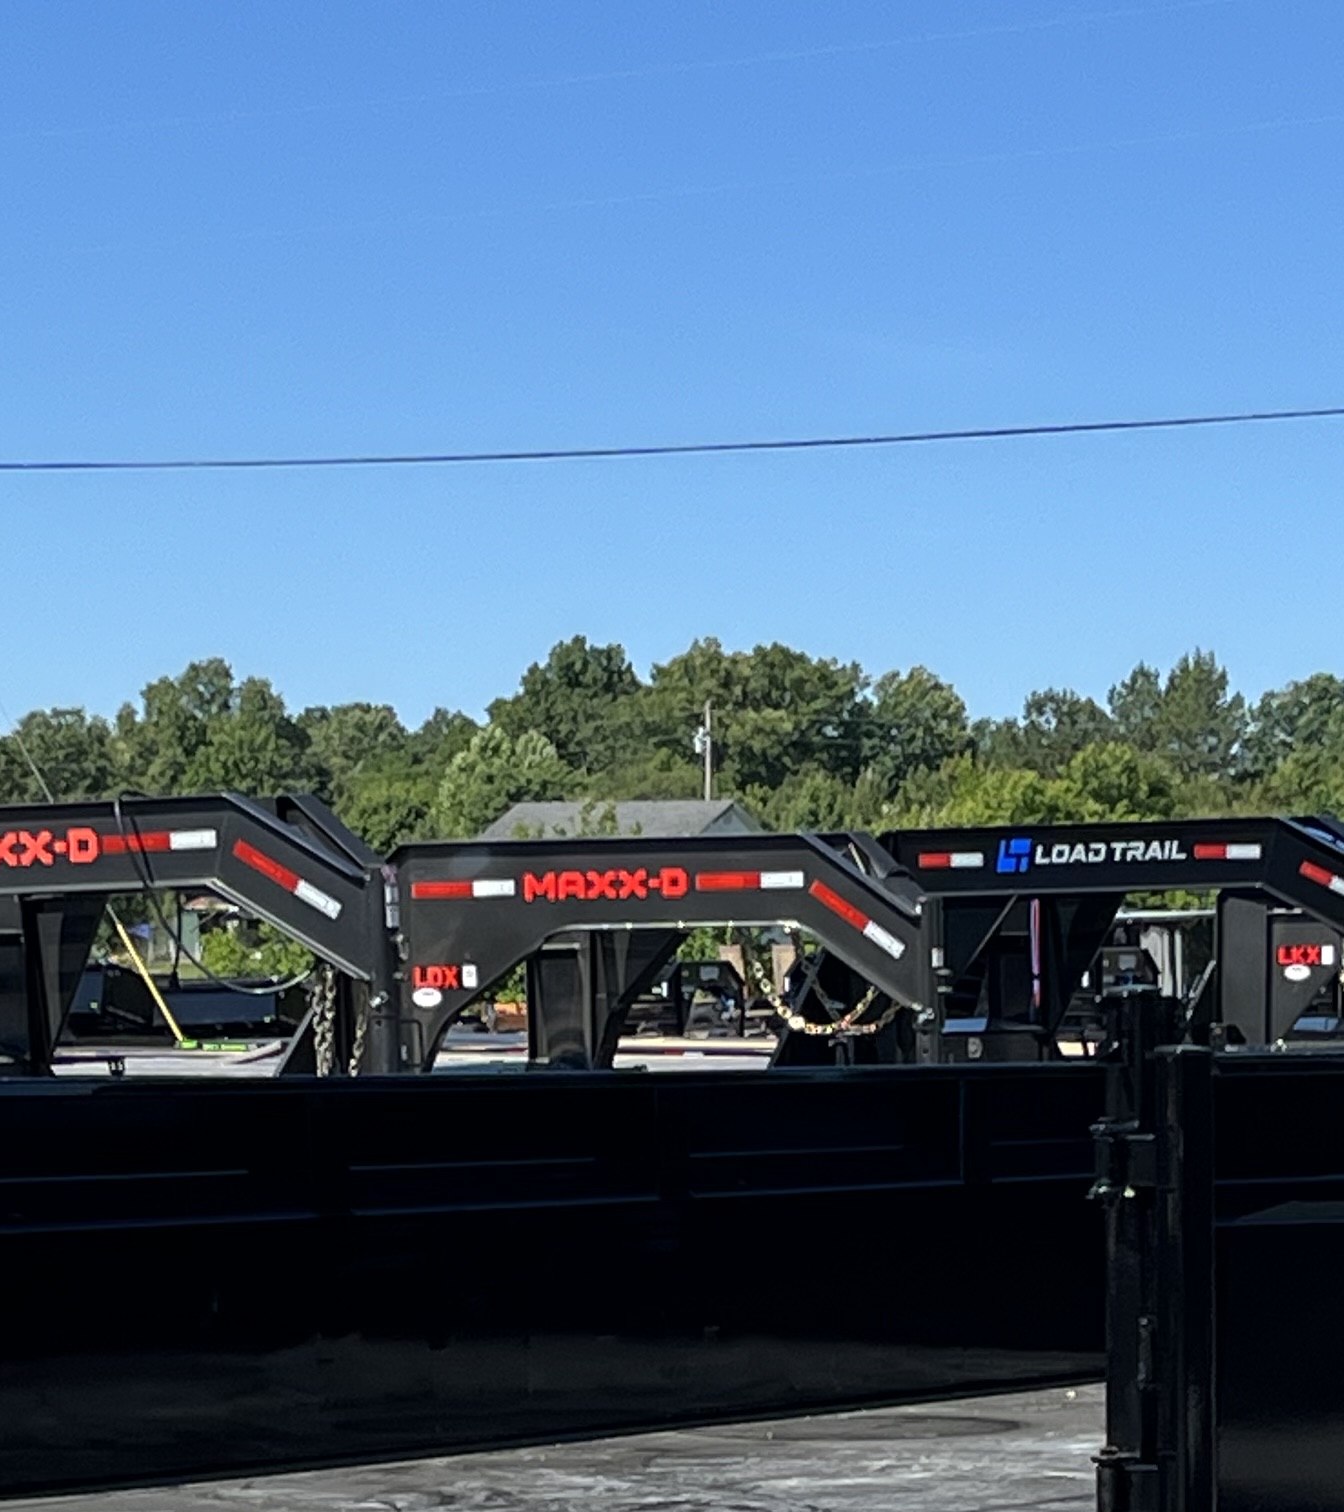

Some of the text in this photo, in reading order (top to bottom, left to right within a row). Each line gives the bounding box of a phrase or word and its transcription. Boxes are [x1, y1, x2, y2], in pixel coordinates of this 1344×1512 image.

[1034, 840, 1187, 865] LOAD TRAIL
[523, 866, 688, 903] MAXX-D
[1277, 945, 1321, 965] LKX
[413, 965, 460, 990] LDX
